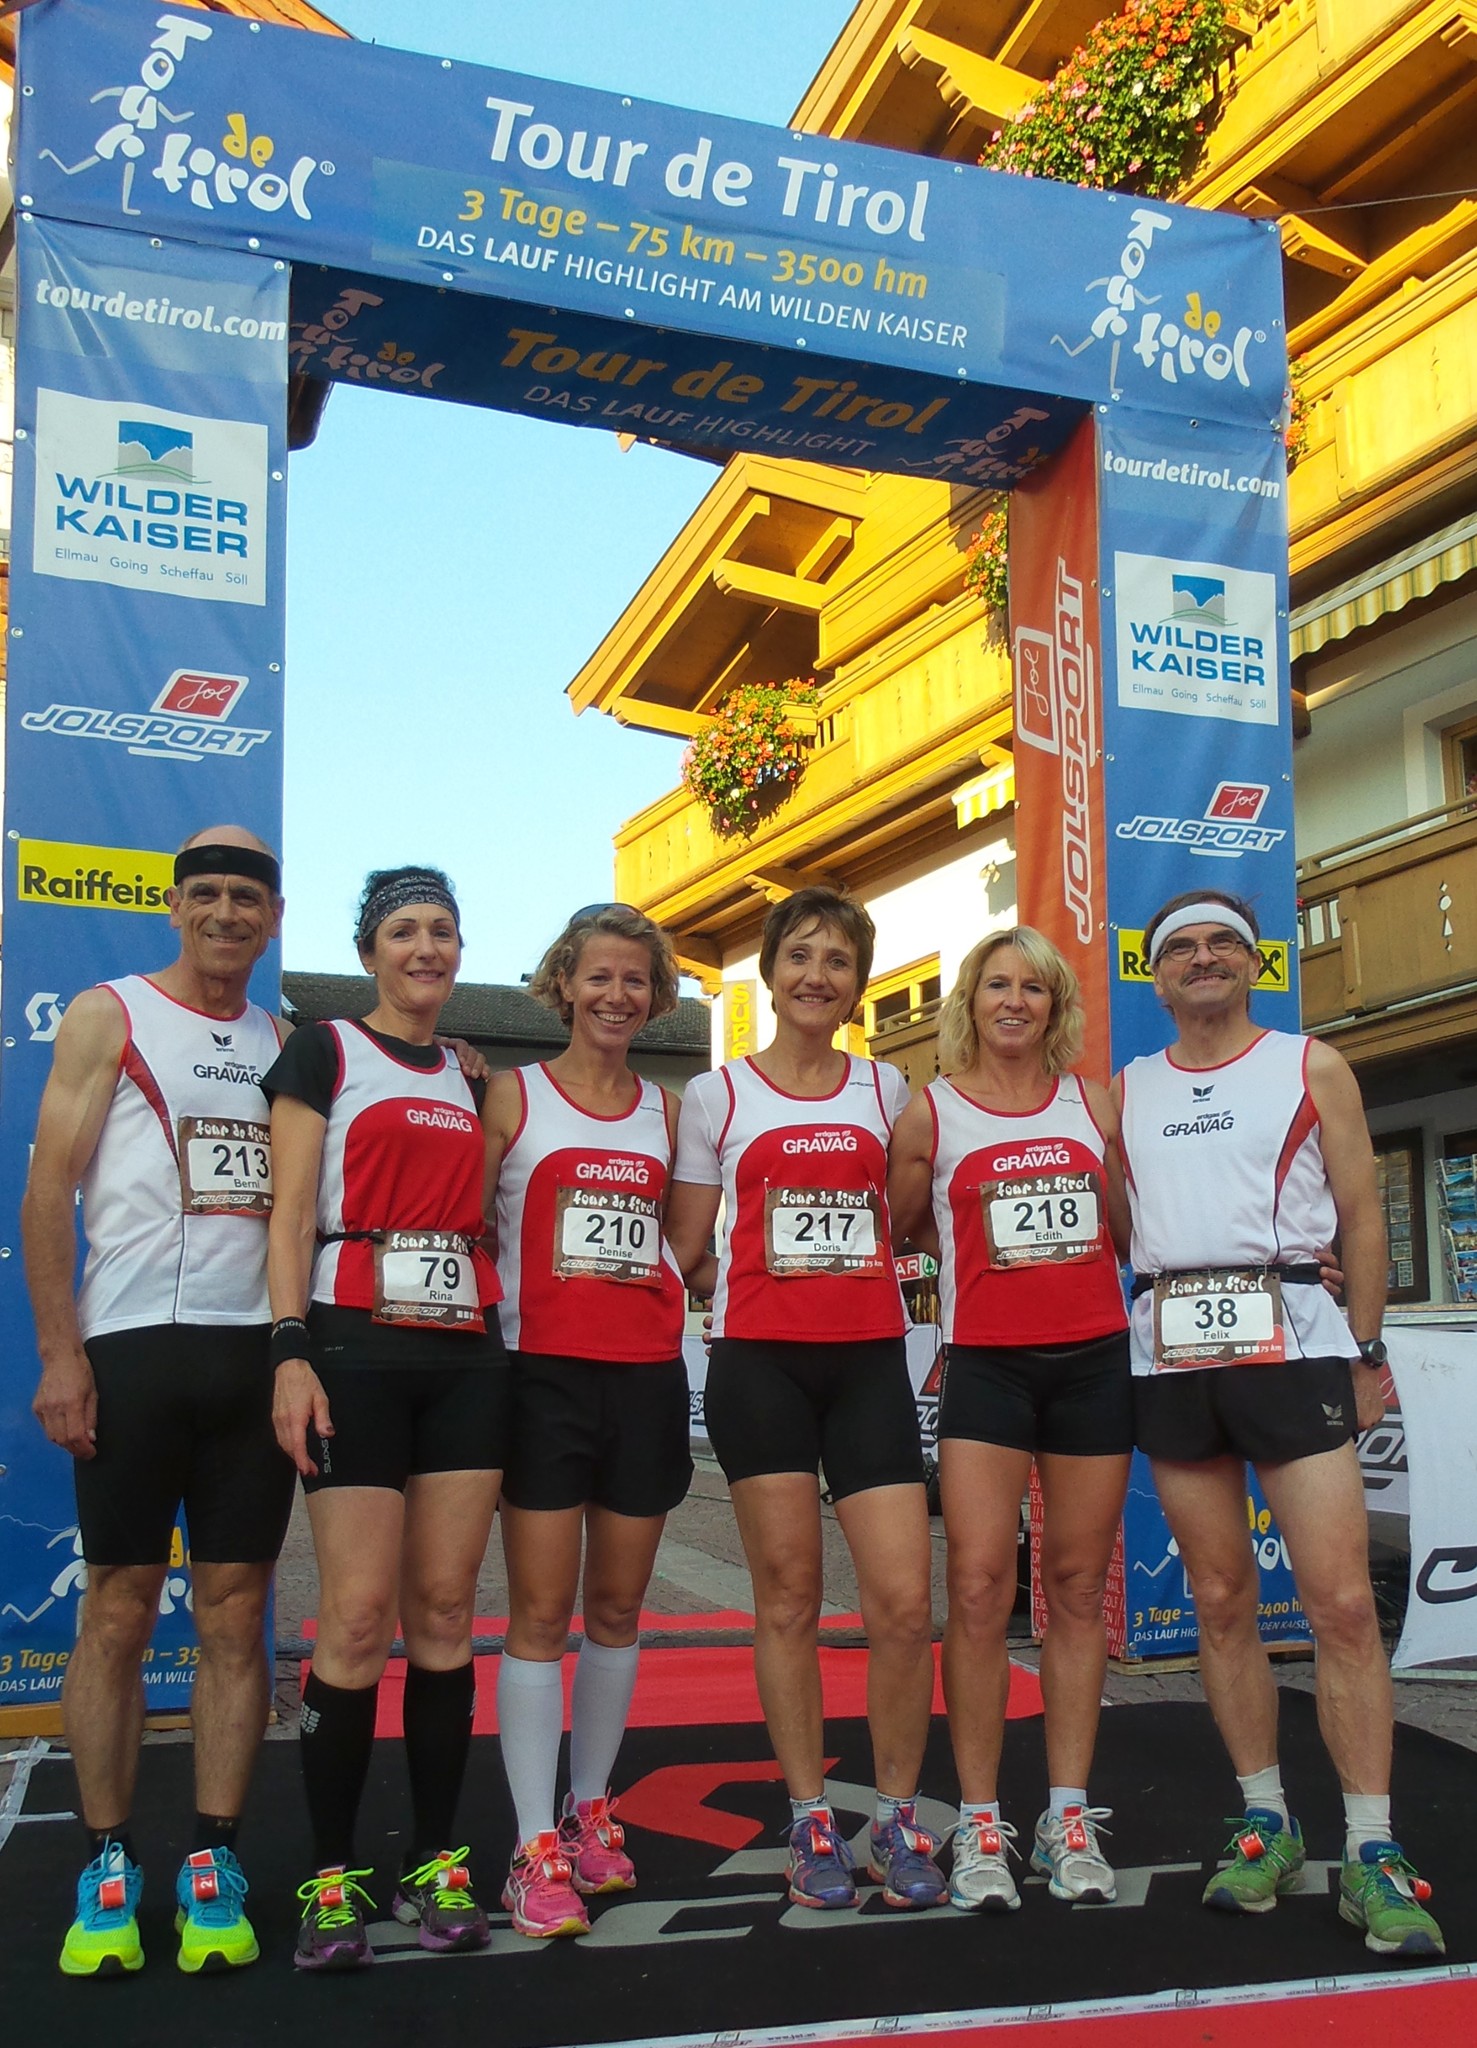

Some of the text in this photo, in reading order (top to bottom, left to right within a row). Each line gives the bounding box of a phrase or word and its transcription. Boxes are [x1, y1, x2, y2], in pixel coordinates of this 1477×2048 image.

[223, 113, 273, 168] de
[486, 96, 930, 242] Tour de Tirol
[458, 189, 485, 221] 3
[499, 187, 587, 238] Tage
[627, 222, 669, 257] 75
[680, 224, 735, 265] km
[772, 250, 864, 286] 3500
[873, 258, 928, 299] hm
[417, 226, 968, 348] DAS LAUF HIGHLIGHT AM WILDEN KAISER
[36, 278, 287, 341] tourdetirol.com
[1183, 291, 1221, 339] de
[322, 345, 445, 389] tirol
[500, 328, 951, 434] Tour de Tirol
[523, 385, 878, 458] DAS LAUF HIGHLIGHT
[1103, 450, 1280, 499] tourdetirol.com
[55, 472, 248, 527] WILDER
[56, 505, 248, 559] KAISER
[55, 547, 248, 586] Ellmau Going Scheffau Söll
[1130, 622, 1264, 660] WILDER
[1132, 650, 1265, 686] KAISER
[177, 677, 231, 710] Jol
[1132, 683, 1267, 710] Ellmau Going Scheffau Söll
[20, 703, 272, 757] JOLSPORT
[1055, 557, 1092, 944] JOLSPORT
[1224, 788, 1260, 815] Jol
[1115, 815, 1287, 852] JOLSPORT
[193, 1064, 263, 1087] GRAVAG
[406, 1109, 472, 1133] GRAVAG
[814, 1130, 840, 1139] erdgas
[1163, 1116, 1235, 1138] GRAVAG
[782, 1137, 858, 1155] GRAVAG
[1025, 1144, 1052, 1153] erdgas
[212, 1144, 269, 1180] 213
[576, 1162, 649, 1184] GRAVAG
[608, 1158, 634, 1167] erdgas
[992, 1150, 1070, 1172] GRAVAG
[234, 1178, 260, 1189] Berni
[191, 1194, 256, 1205] JOLSPORT
[794, 1212, 855, 1242] 217
[1013, 1198, 1079, 1232] 218
[585, 1213, 645, 1249] 210
[1035, 1230, 1063, 1242] Edith
[599, 1246, 633, 1259] Denise
[814, 1243, 841, 1252] Doris
[997, 1246, 1058, 1260] JOLSPORT
[420, 1257, 460, 1290] 79
[561, 1258, 623, 1271] JOLSPORT
[774, 1257, 836, 1266] JOLSPORT
[429, 1290, 453, 1301] Rina
[381, 1304, 448, 1317] JOLSPORT
[1195, 1298, 1238, 1329] 38
[1203, 1331, 1230, 1340] Felix
[1162, 1345, 1225, 1358] JOLSPORT
[1133, 1611, 1144, 1628] 3
[1148, 1606, 1181, 1626] Tage
[1134, 1630, 1152, 1642] DAS
[1155, 1628, 1180, 1640] LAUF
[0, 1654, 13, 1674] 3
[20, 1648, 70, 1673] Tage
[0, 1678, 26, 1692] DAS
[30, 1676, 64, 1689] LAUF
